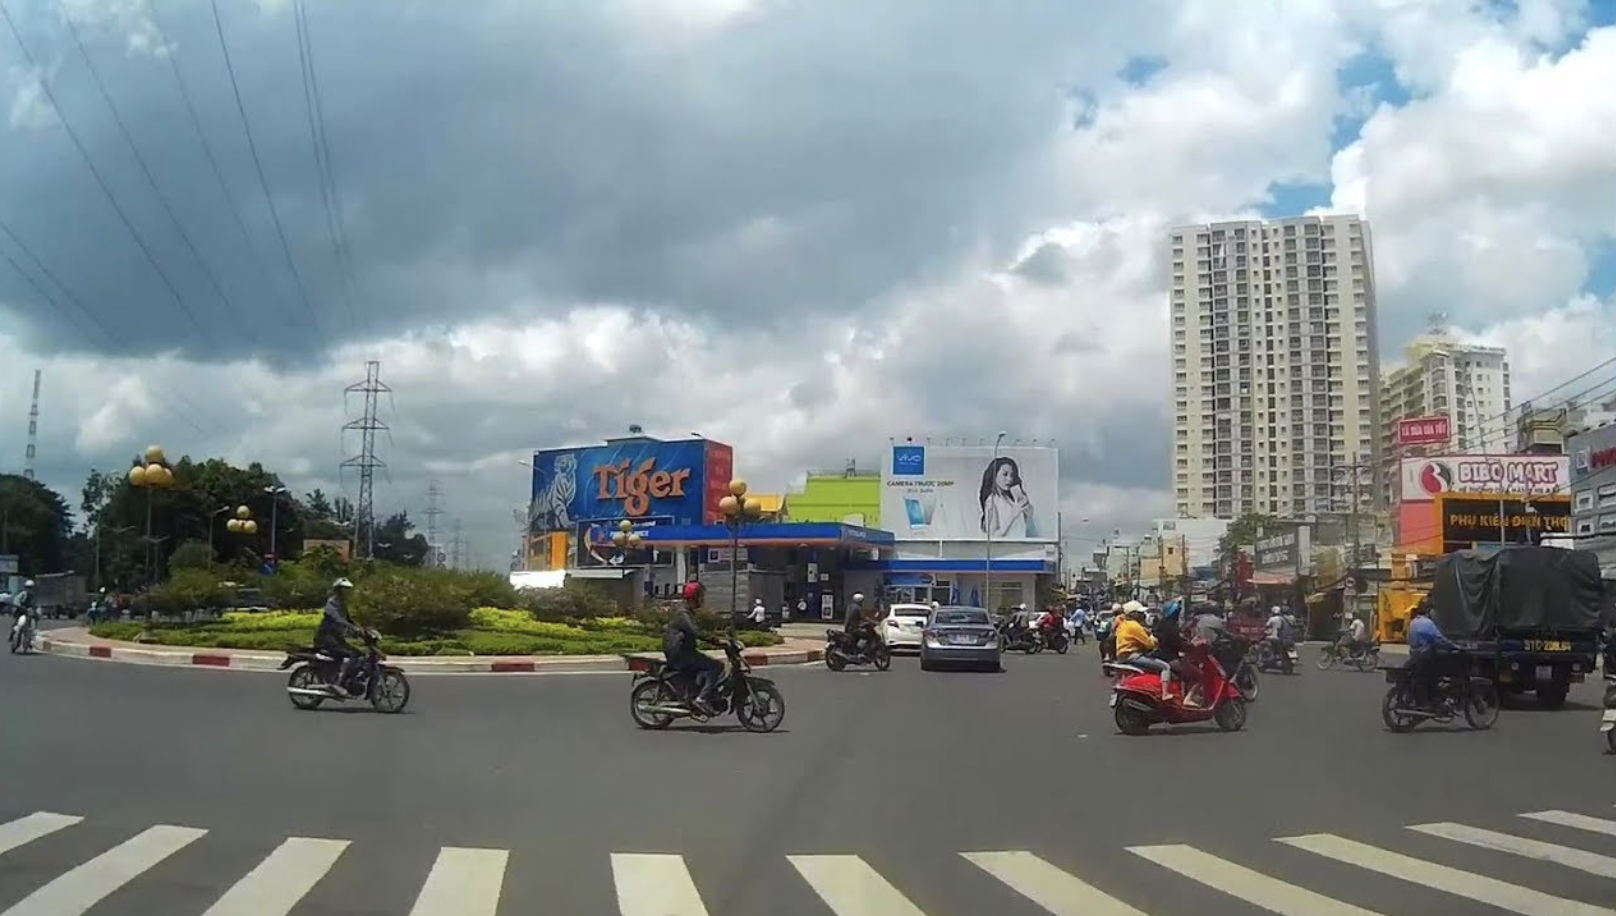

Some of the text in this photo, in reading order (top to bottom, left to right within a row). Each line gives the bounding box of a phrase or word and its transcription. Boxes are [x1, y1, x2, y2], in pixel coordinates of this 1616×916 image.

[593, 457, 691, 517] Tiger
[1459, 461, 1559, 484] BIBO MART
